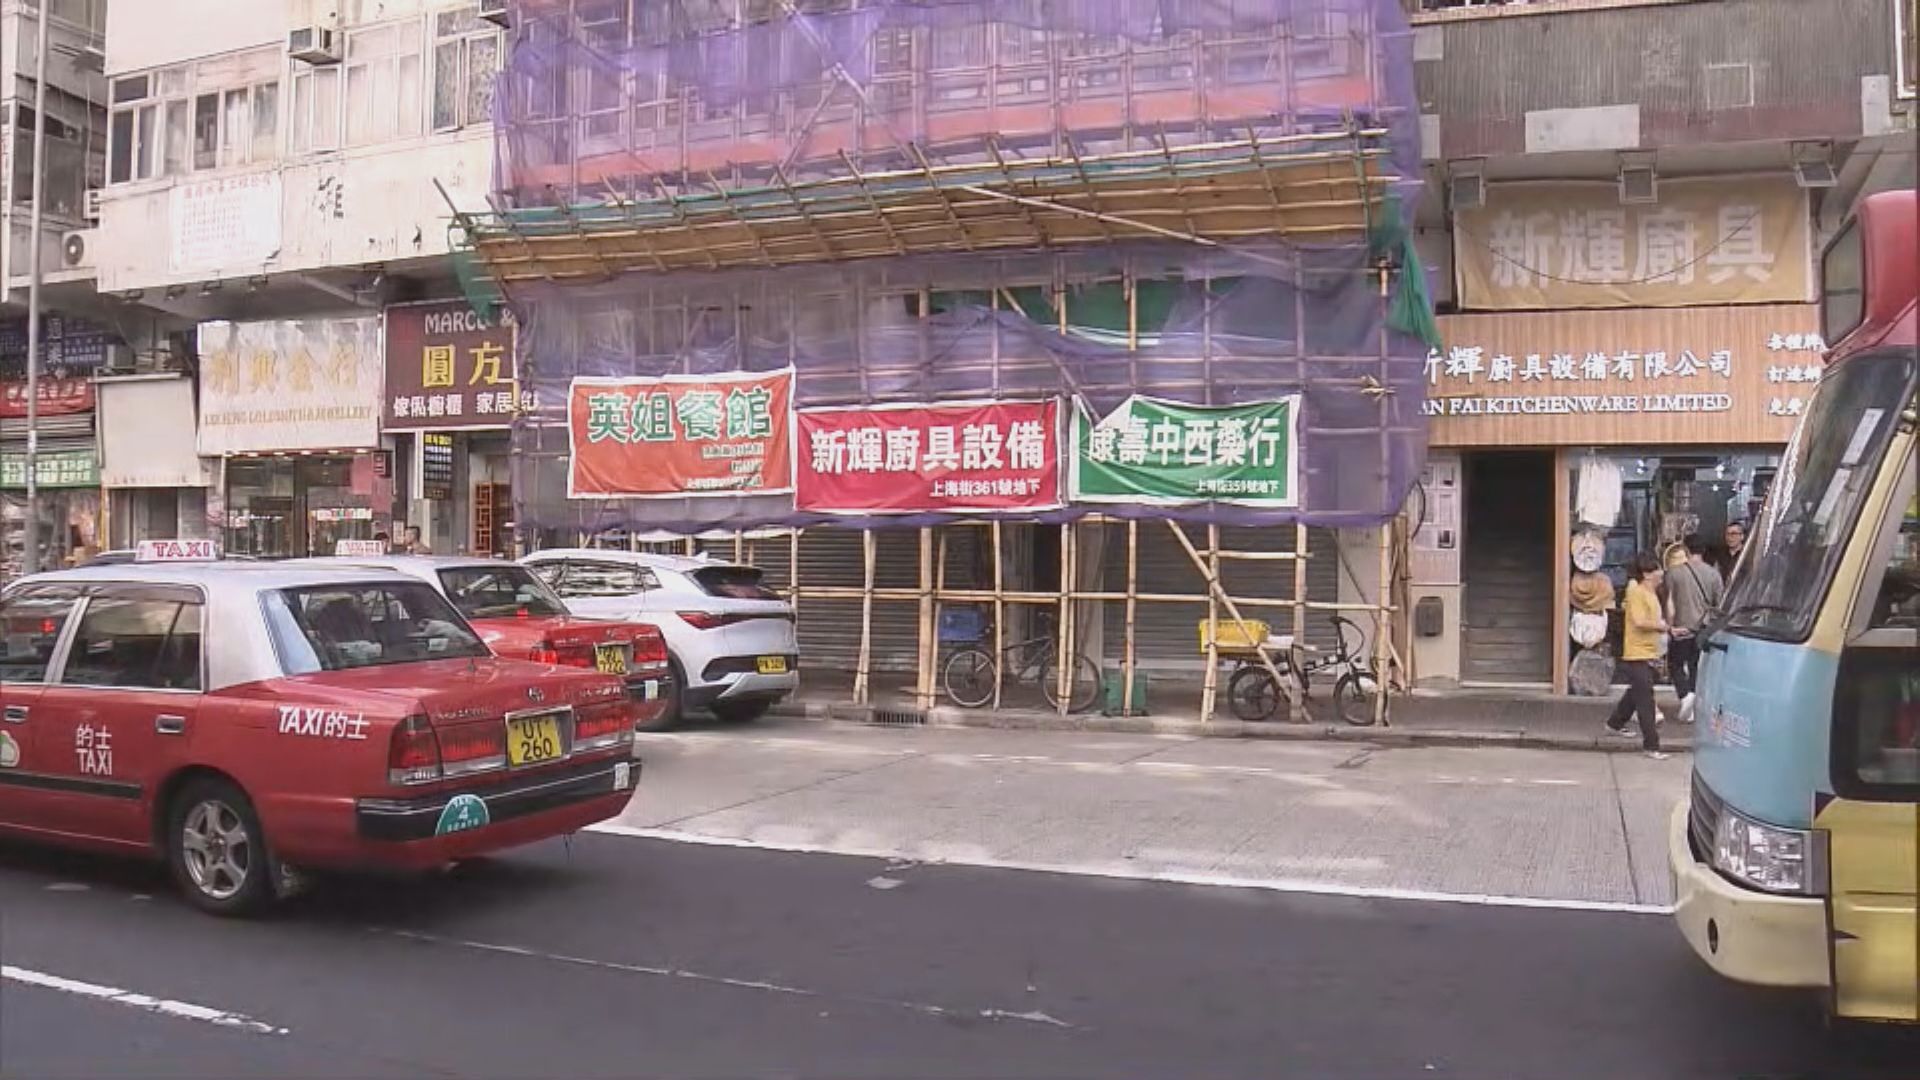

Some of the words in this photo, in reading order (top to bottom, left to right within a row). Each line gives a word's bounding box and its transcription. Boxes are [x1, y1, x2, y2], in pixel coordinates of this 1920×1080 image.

[1489, 206, 1774, 289] 新輝廚具
[423, 340, 504, 387] 圓方
[588, 385, 773, 444] 英姐餐館
[1449, 397, 1483, 415] FAI
[1485, 395, 1639, 414] KITCHENWARE
[1643, 393, 1732, 412] LIMITED
[811, 420, 1047, 475] 新輝廚具設備
[930, 478, 1042, 498] 上海街361號地下
[152, 542, 211, 558] TAXI
[278, 705, 325, 736] TAXI
[323, 710, 371, 739] 的士
[523, 718, 544, 740] UT
[76, 723, 113, 750] 的士
[520, 737, 553, 761] 260
[76, 748, 113, 775] TAXI
[457, 805, 469, 820] 4
